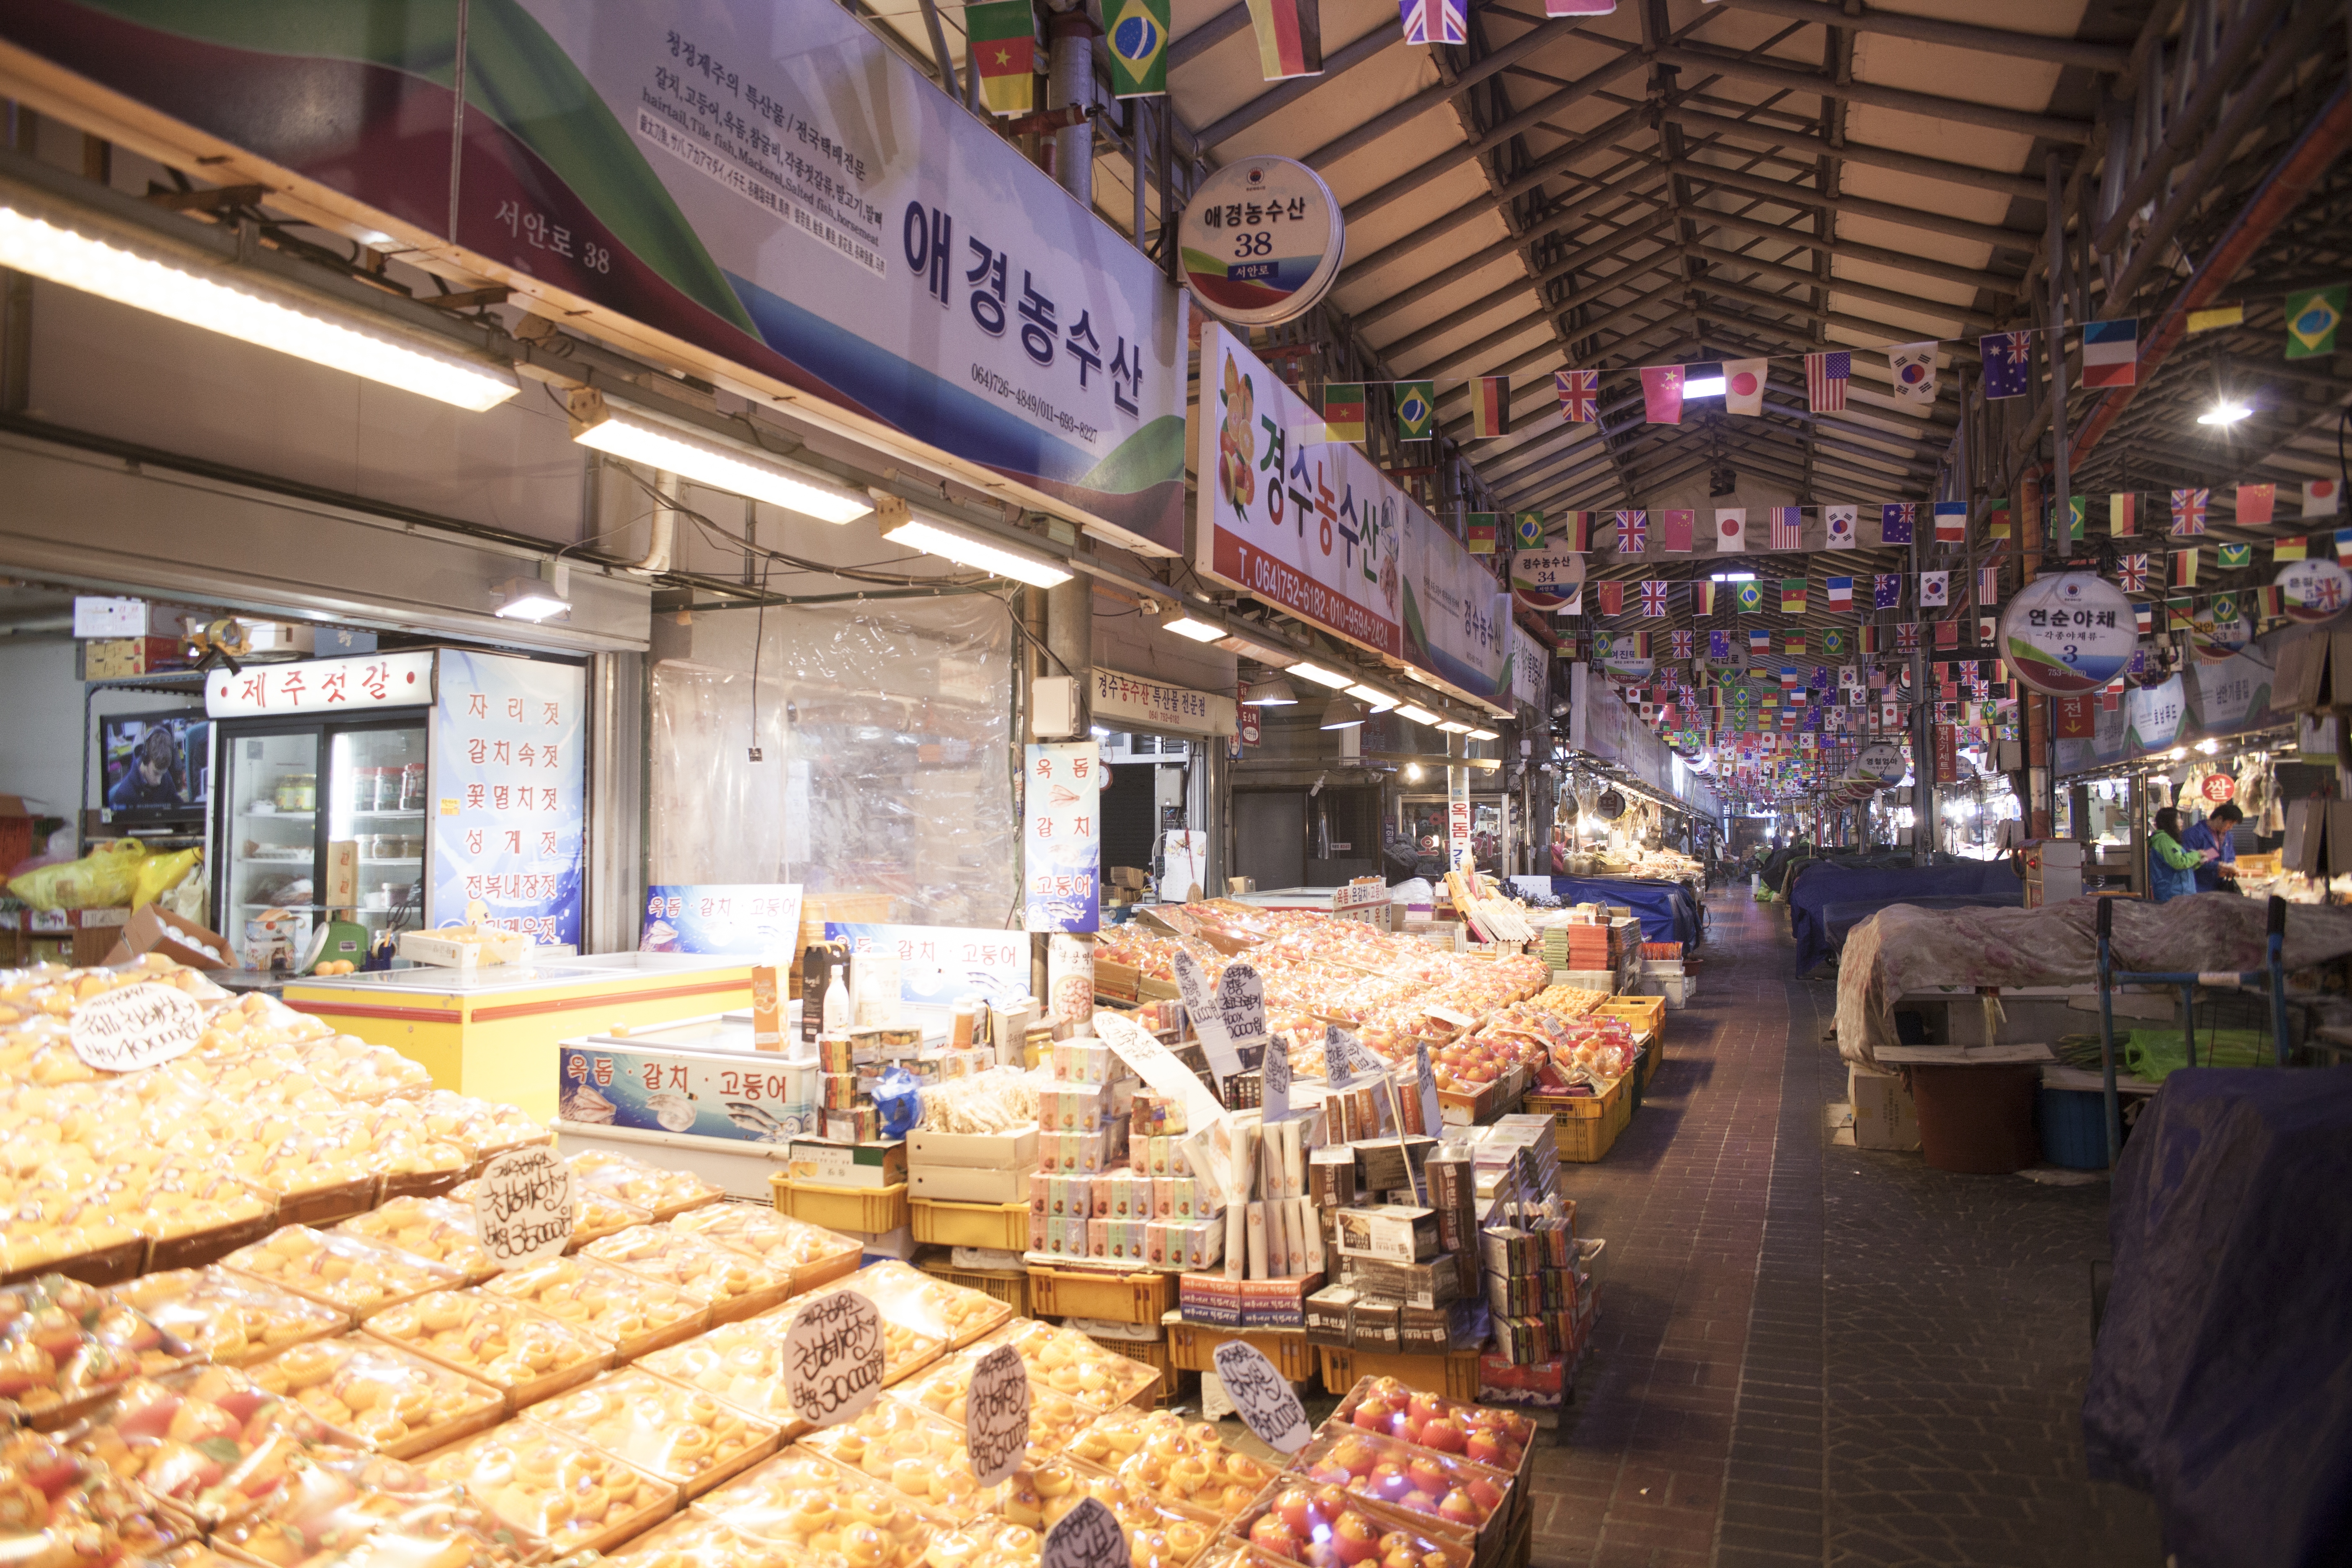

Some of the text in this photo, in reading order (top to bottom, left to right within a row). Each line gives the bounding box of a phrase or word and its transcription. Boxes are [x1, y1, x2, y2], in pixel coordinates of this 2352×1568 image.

[667, 30, 739, 98] 청정제주의
[745, 84, 785, 128] 특산물
[1204, 196, 1306, 228] 애경농수산
[494, 200, 610, 274] 서안로 38
[1234, 232, 1272, 258] 38
[1235, 265, 1269, 278] 서안로
[903, 200, 1143, 418] 애경농수산
[1260, 413, 1379, 585] 경수농수산
[1238, 547, 1251, 587] T.
[1523, 556, 1570, 570] 경수농수산
[1537, 570, 1556, 583] 34
[1464, 599, 1501, 656] 경수농수산
[2028, 609, 2116, 628] 연순야채
[2061, 645, 2078, 663] 3
[241, 662, 389, 708] 제주젓갈
[1098, 674, 1205, 717] 경수농수산 특산물 전문점
[469, 694, 560, 725] 자리젓
[1148, 710, 1180, 725] 064) 752-6182
[468, 738, 559, 768] 갈치속젓
[1938, 726, 1950, 770] 발신기세트
[1036, 757, 1089, 779] 옥돔
[467, 783, 557, 811] 꽃멸치젓
[2205, 779, 2231, 801] 쌀
[1599, 794, 1619, 818] 떡
[1036, 816, 1090, 838] 갈치
[465, 829, 557, 854] 성게젓
[465, 873, 557, 900] 전복내장젓
[1037, 875, 1091, 897] 고등어
[649, 897, 796, 918] 옥돔 갈치 고등어
[897, 940, 935, 962] 갈치
[961, 943, 1017, 968] 고등어
[568, 1055, 787, 1104] 옥돔 갈치 고등어
[1321, 1318, 1346, 1330] 크런치
[1404, 1328, 1431, 1338] 크런치
